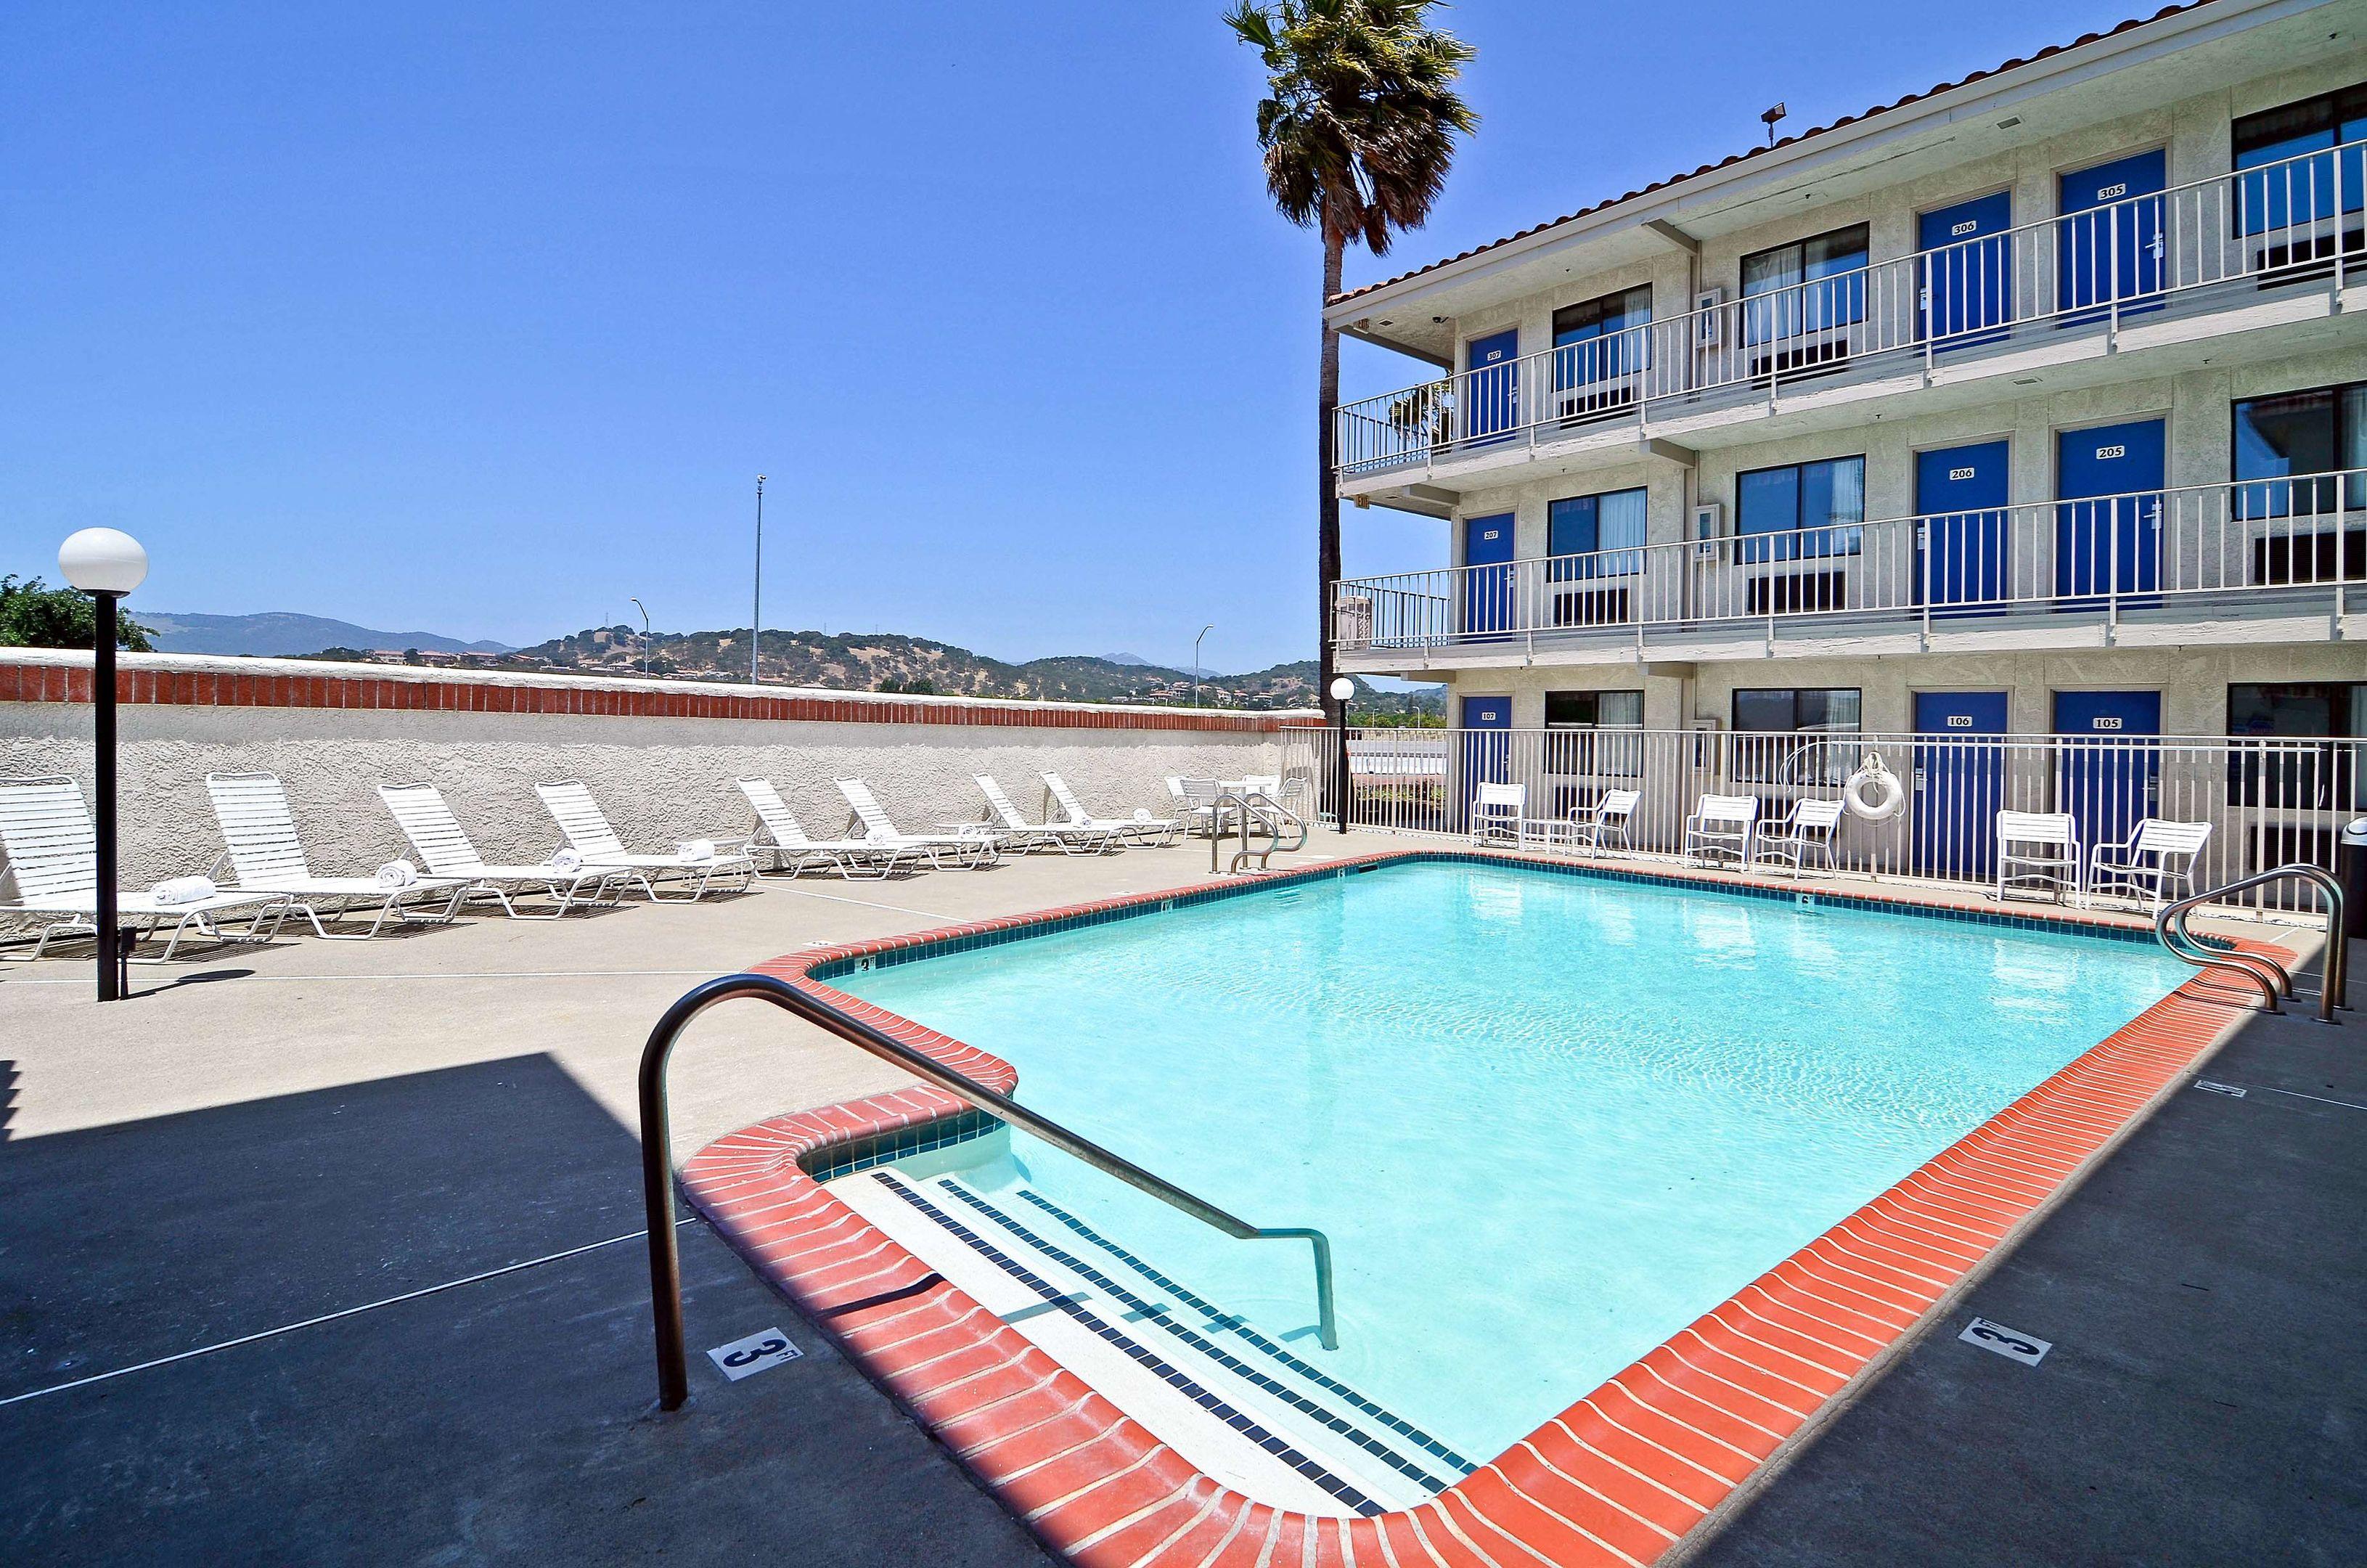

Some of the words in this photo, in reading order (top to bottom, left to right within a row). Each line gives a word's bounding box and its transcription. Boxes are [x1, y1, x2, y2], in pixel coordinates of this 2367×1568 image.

[2100, 185, 2124, 198] 305
[1954, 221, 1974, 234] 306
[1489, 351, 1500, 360] 307
[2098, 447, 2122, 458] 205
[1952, 469, 1972, 478] 206
[2097, 719, 2119, 727] 105
[1971, 1327, 2040, 1355] 3
[722, 1339, 787, 1368] 3
[776, 1349, 798, 1360] FT
